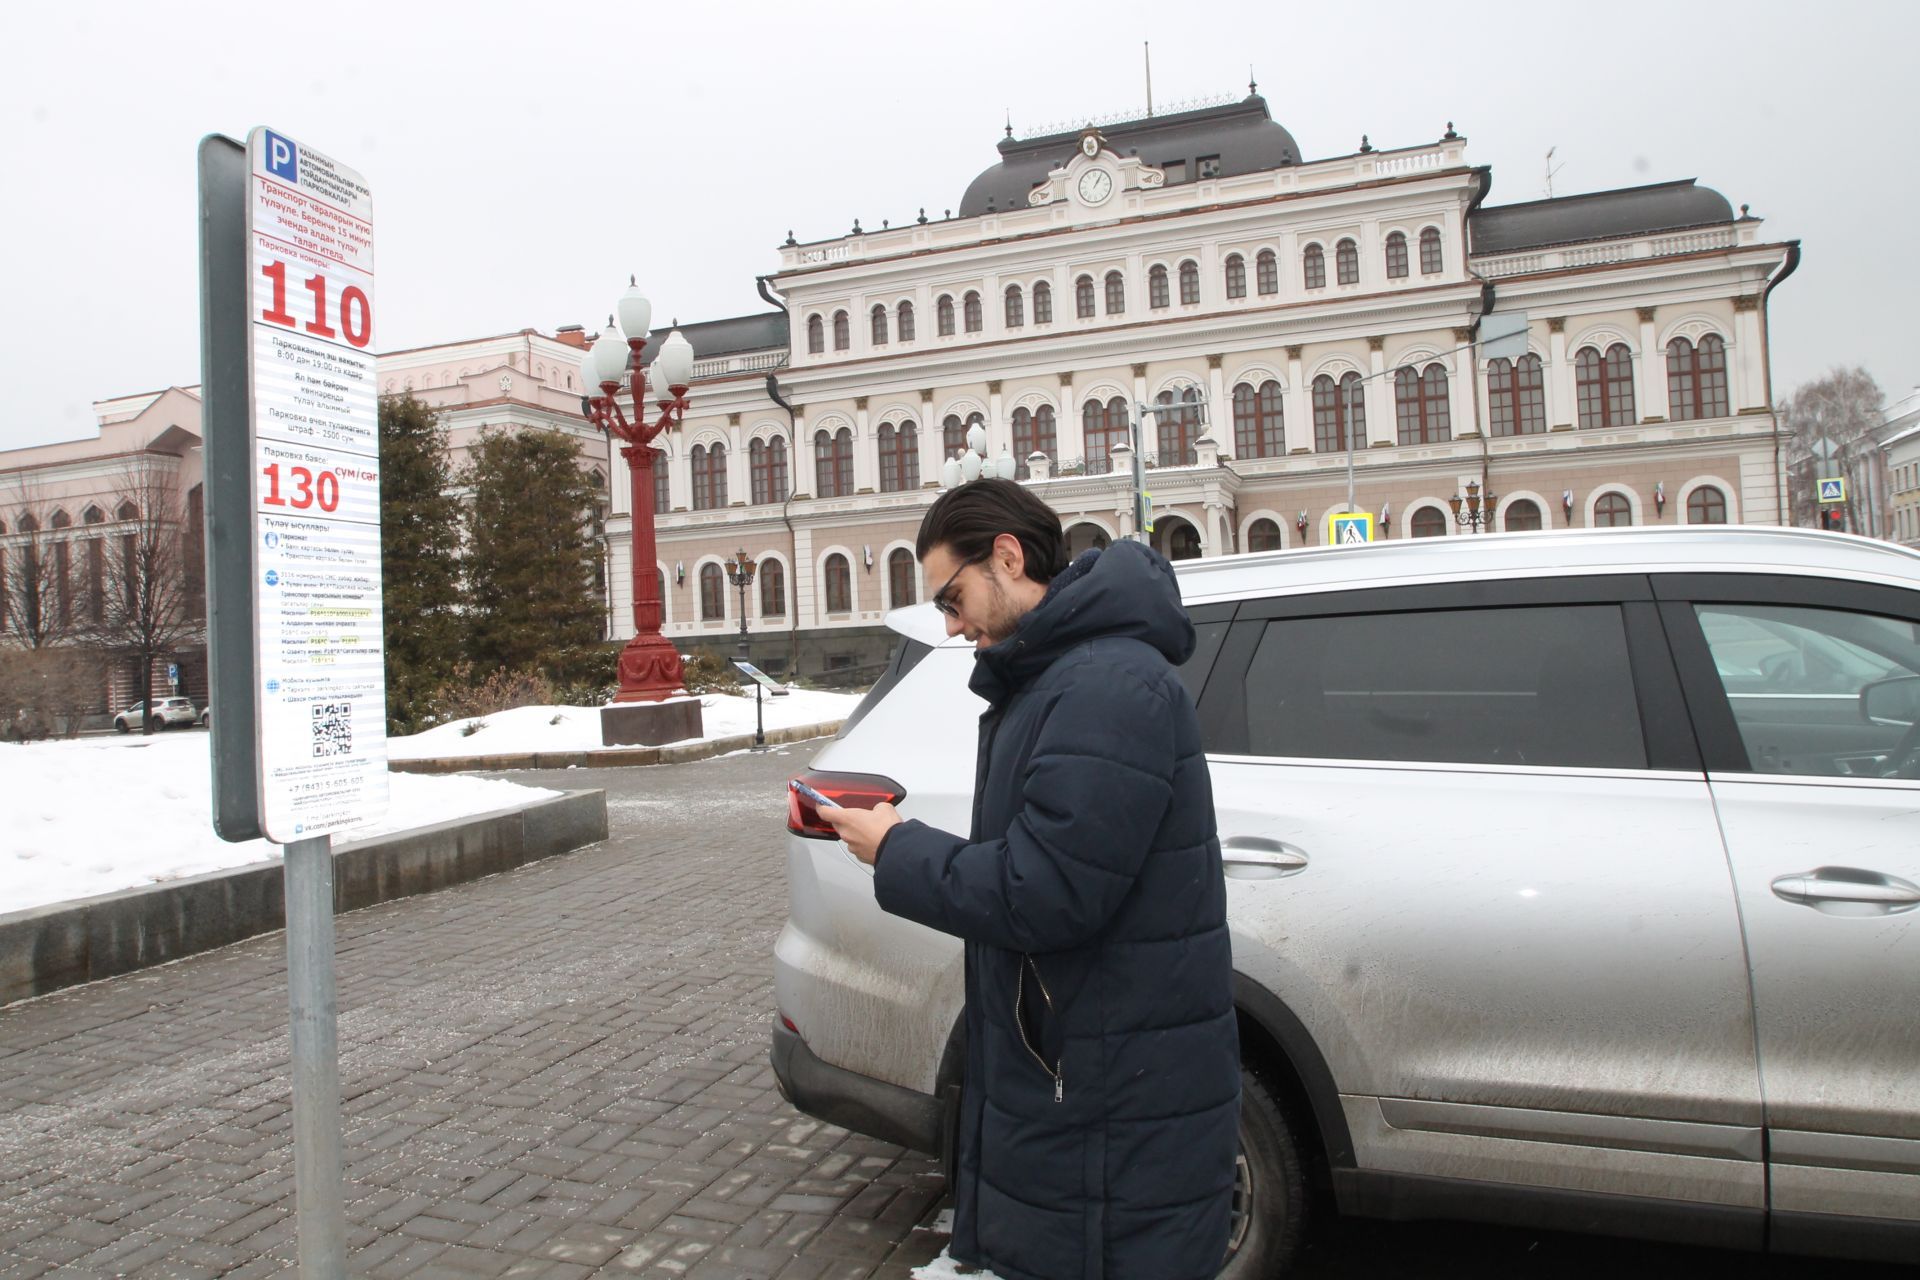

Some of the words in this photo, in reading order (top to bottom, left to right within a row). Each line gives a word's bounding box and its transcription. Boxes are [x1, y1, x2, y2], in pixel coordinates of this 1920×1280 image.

[272, 137, 291, 171] P
[259, 195, 300, 218] түләүле.
[301, 210, 337, 232] Беренче
[338, 224, 347, 237] 15
[348, 231, 372, 249] минут
[260, 180, 308, 208] Транспорт
[309, 203, 354, 228] чараларын
[355, 223, 371, 235] кую
[277, 216, 309, 234] эчендә
[310, 226, 335, 243] алдан
[337, 238, 359, 257] түләү
[293, 235, 318, 252] таләп
[320, 246, 346, 262] ителә.
[259, 237, 298, 257] Парковка
[299, 251, 331, 269] номеры:
[261, 259, 371, 349] 110
[272, 337, 326, 360] Парковканың
[326, 353, 337, 362] эш
[277, 350, 295, 362] 8:00
[296, 356, 311, 366] дән
[343, 369, 363, 382] кадәр
[295, 372, 306, 382] Ял
[306, 374, 322, 386] һәм
[322, 380, 350, 394] бәйрәм
[269, 407, 308, 424] Парковка
[308, 416, 328, 427] өчен
[316, 402, 352, 415] алынмый
[287, 423, 315, 436] штраф
[322, 429, 341, 441] 2500
[264, 446, 304, 462] Парковка
[262, 463, 340, 513] 130
[265, 517, 290, 529] Түләү
